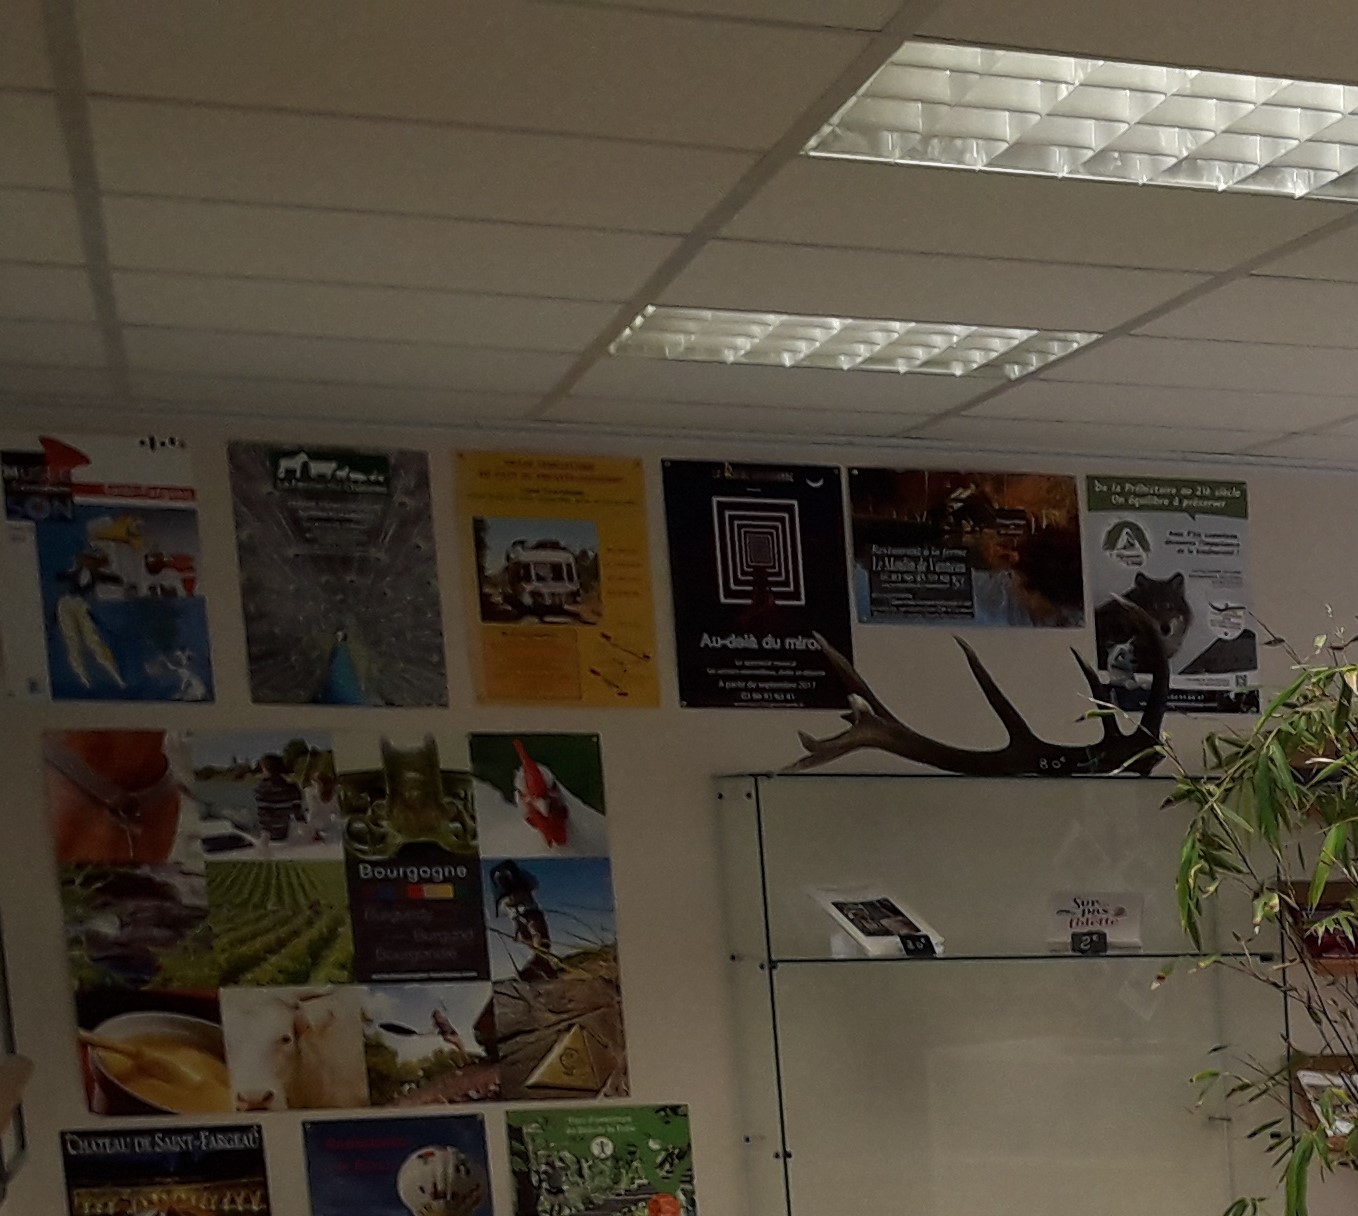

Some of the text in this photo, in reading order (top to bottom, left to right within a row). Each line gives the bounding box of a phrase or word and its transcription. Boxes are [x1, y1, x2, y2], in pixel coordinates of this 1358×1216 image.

[1095, 480, 1108, 492] De
[1111, 496, 1126, 506] Un
[1127, 496, 1169, 508] équilibre
[1182, 498, 1227, 510] préserver
[699, 632, 759, 650] Au-delà
[761, 634, 782, 650] du
[358, 861, 468, 883] Bourgogne
